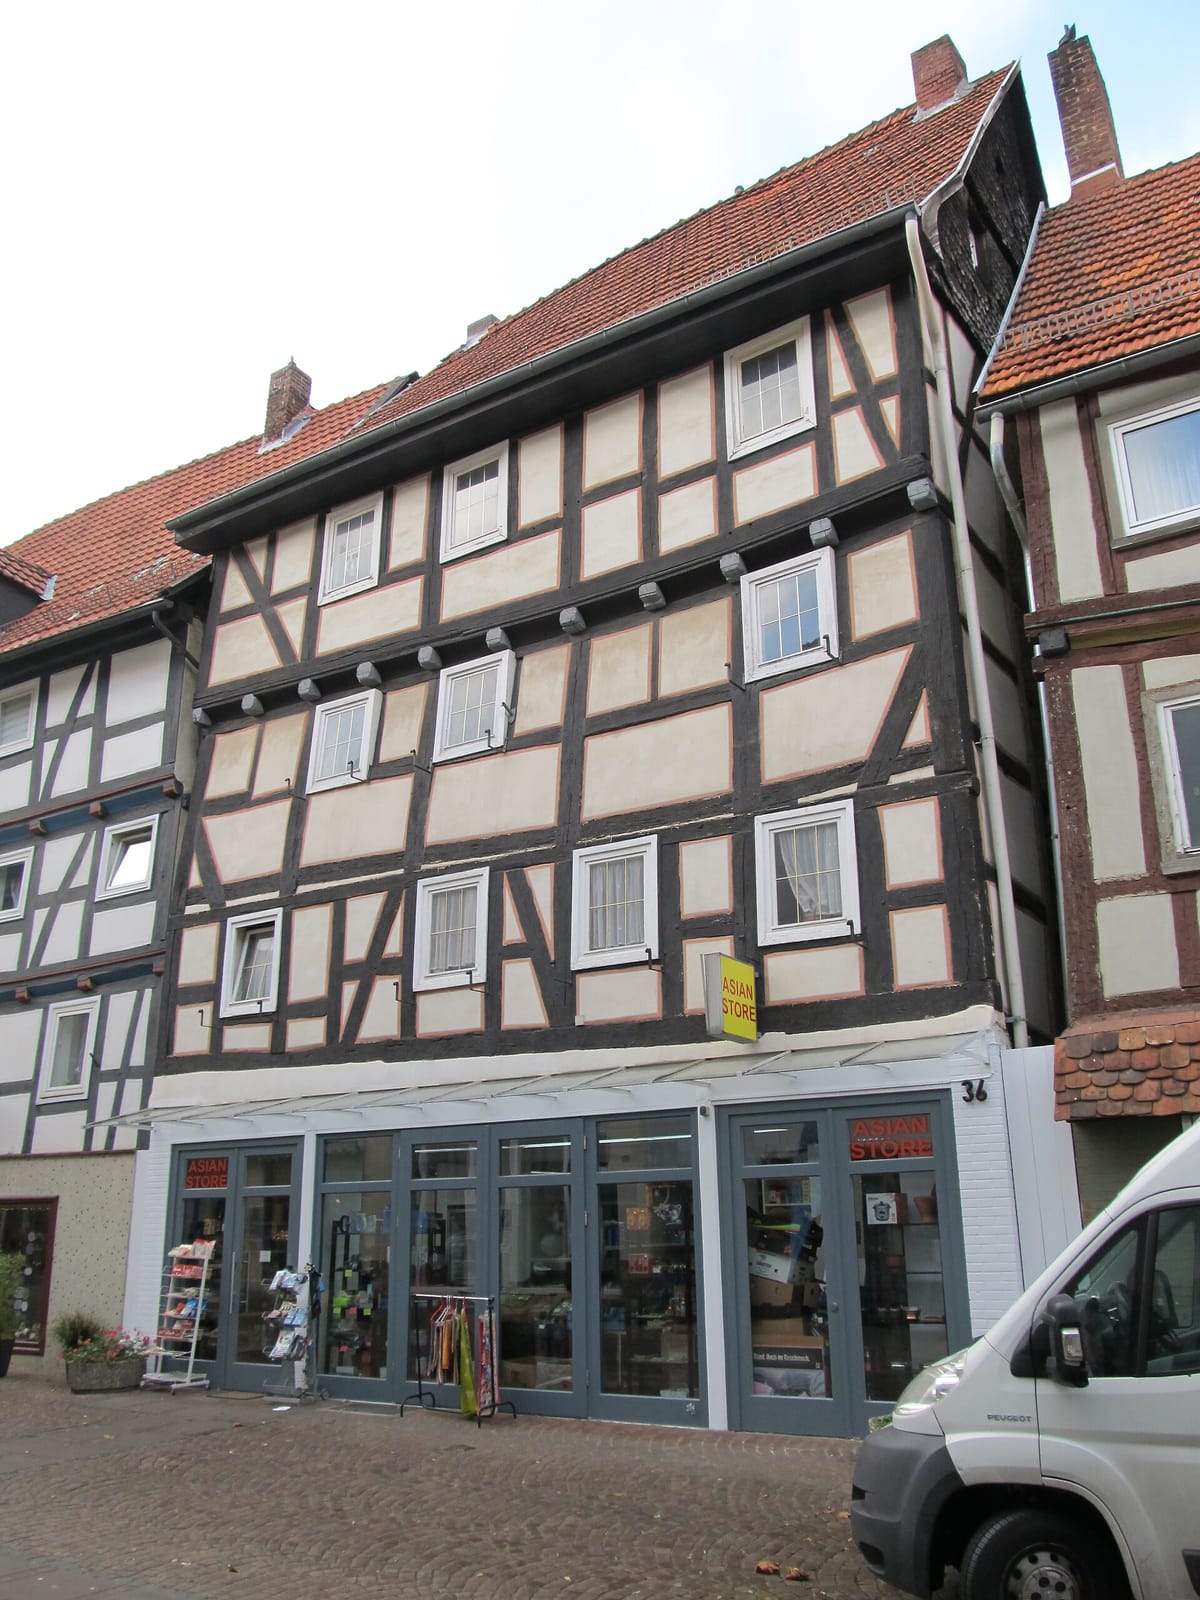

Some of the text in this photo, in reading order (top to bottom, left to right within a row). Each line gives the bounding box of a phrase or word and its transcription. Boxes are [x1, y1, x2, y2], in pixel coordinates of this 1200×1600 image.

[722, 976, 753, 1000] ASIAN
[721, 997, 756, 1022] STORE
[961, 1079, 987, 1102] 36
[853, 1115, 928, 1137] ASIAN
[851, 1137, 931, 1159] STORE
[188, 1159, 226, 1172] ASIAN
[185, 1174, 228, 1188] STORE
[987, 1414, 1032, 1423] PEUGEOT
